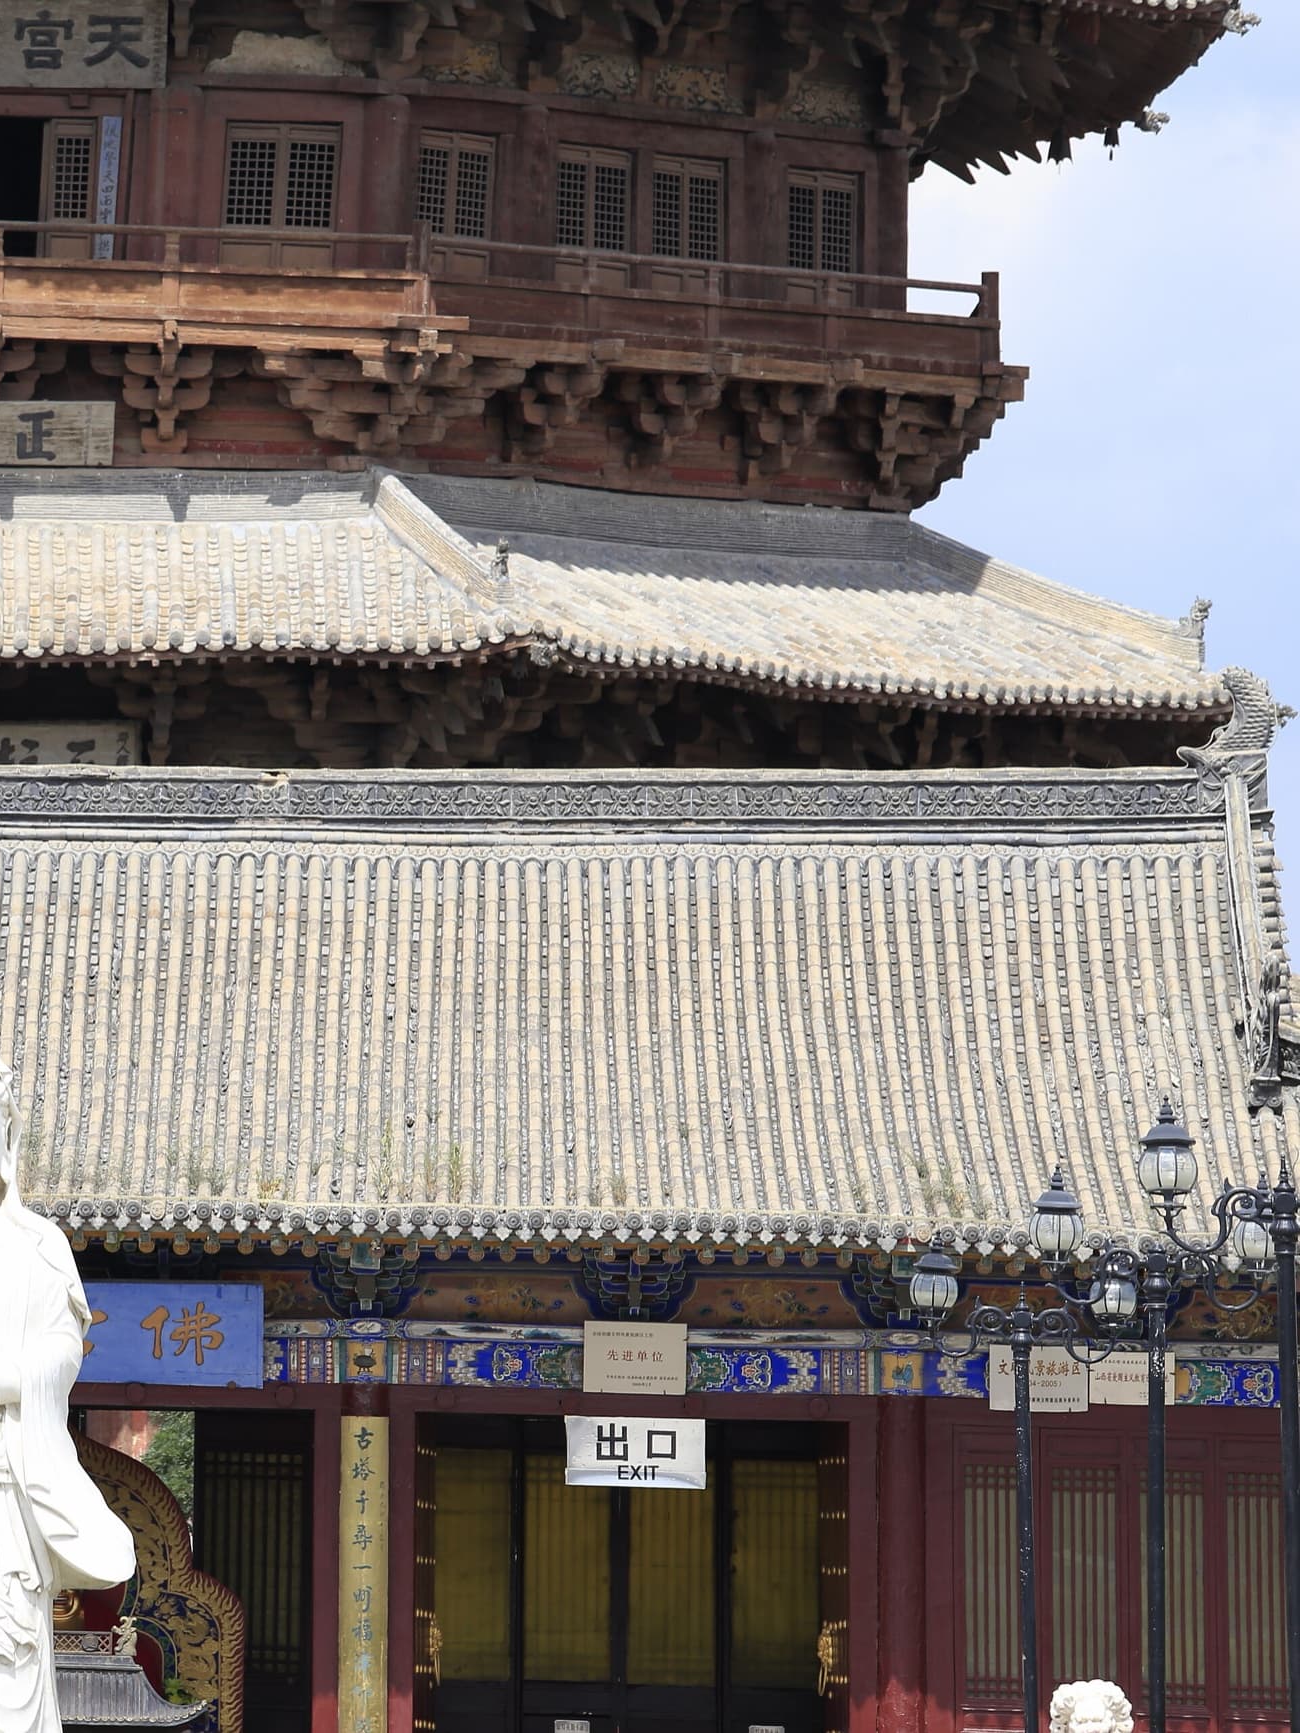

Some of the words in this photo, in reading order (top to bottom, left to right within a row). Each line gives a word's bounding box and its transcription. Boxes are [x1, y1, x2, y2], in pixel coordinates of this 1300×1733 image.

[606, 1350, 663, 1362] 先进单位
[997, 1359, 1081, 1377] 文景旅游区
[596, 1423, 677, 1461] 出口
[617, 1465, 660, 1480] EXIT
